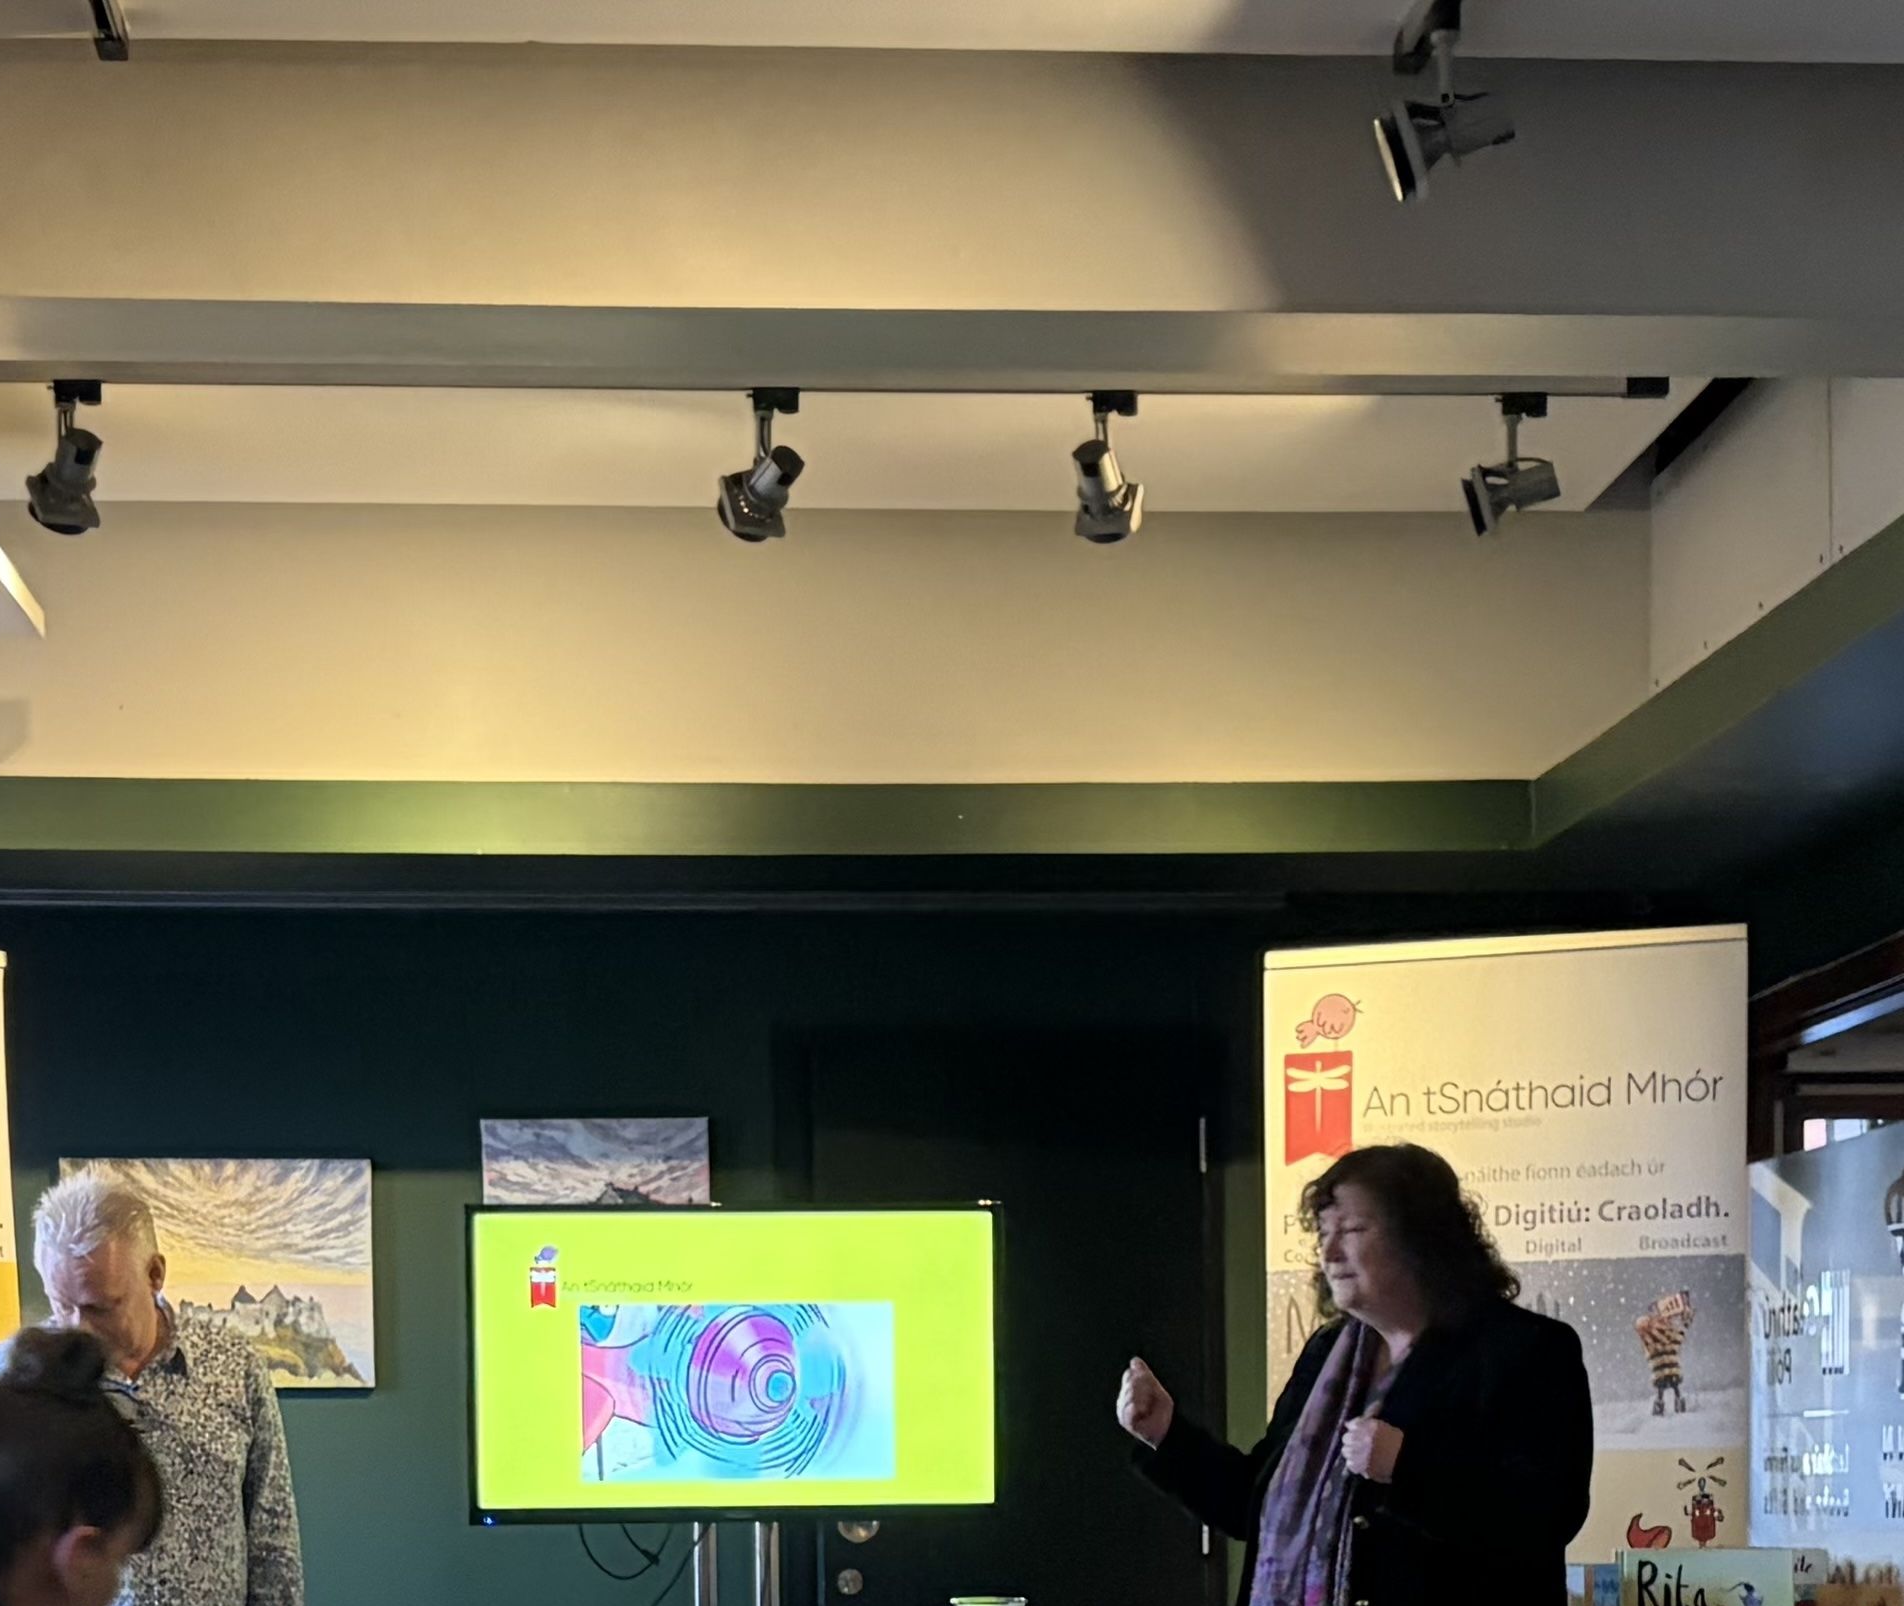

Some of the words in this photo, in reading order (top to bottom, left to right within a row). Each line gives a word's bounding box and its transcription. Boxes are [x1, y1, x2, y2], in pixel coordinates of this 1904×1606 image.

[1362, 1085, 1411, 1118] An
[1423, 1074, 1612, 1115] tSnáthaid
[1627, 1067, 1724, 1106] Mhór
[1526, 1164, 1571, 1181] fionn
[1494, 1200, 1591, 1231] Digitiú:
[1598, 1195, 1730, 1223] Craoladh.
[1525, 1237, 1582, 1256] Digital
[1639, 1233, 1729, 1251] Broadcast
